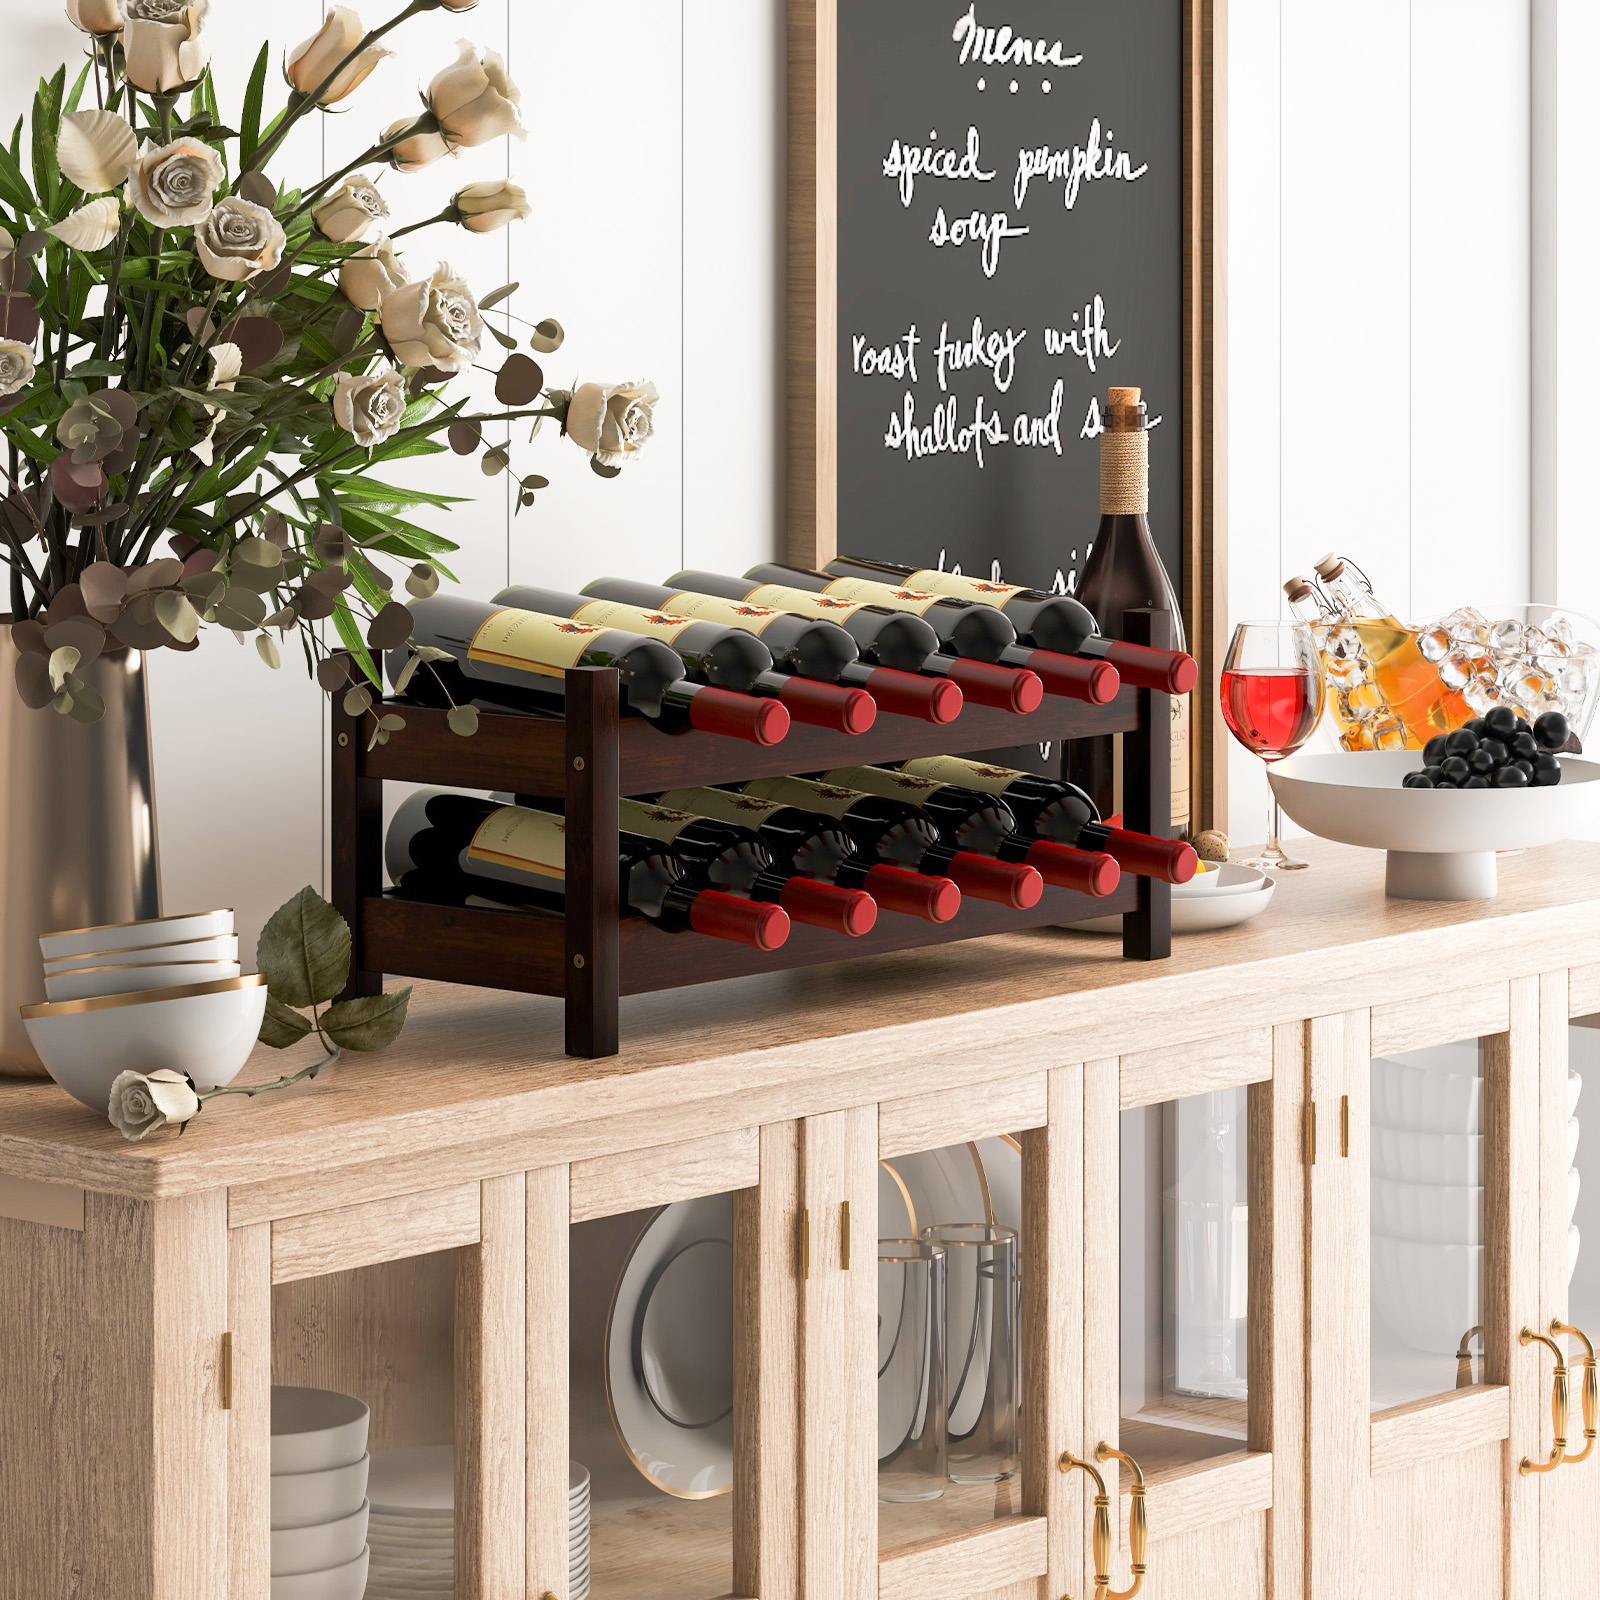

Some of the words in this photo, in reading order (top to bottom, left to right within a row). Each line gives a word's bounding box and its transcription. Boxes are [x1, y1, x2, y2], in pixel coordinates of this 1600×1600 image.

[952, 3, 1083, 67] Menu
[882, 125, 996, 208] spiced
[1013, 117, 1148, 210] pumpkin
[928, 206, 1029, 278] soup
[852, 324, 921, 383] roast
[933, 316, 1027, 393] turkey
[1044, 293, 1121, 373] with
[884, 390, 1009, 469] shallots
[1013, 378, 1064, 456] and
